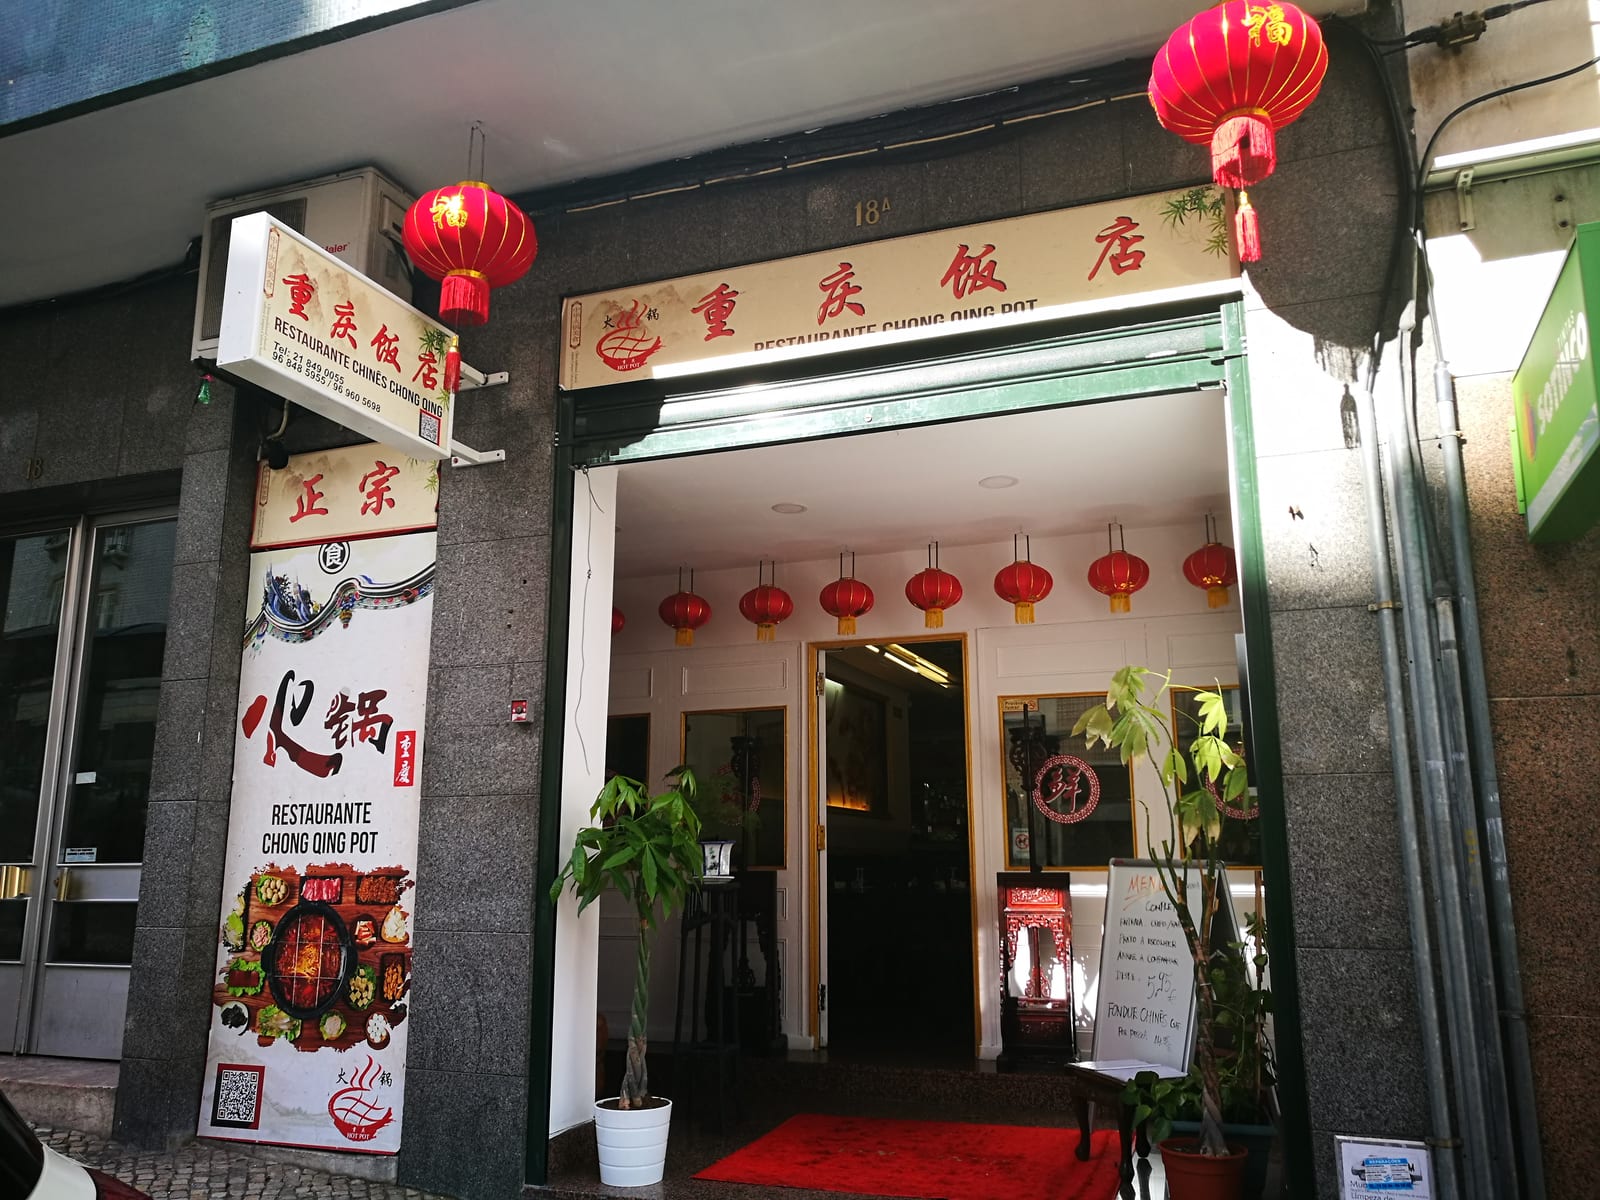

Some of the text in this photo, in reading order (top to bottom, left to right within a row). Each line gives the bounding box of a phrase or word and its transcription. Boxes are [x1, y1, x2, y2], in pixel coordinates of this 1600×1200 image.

[322, 243, 348, 254] aier
[690, 216, 1146, 342] 重庆饭店
[282, 274, 438, 391] 重庆饭店
[272, 352, 284, 364] 96
[286, 359, 302, 373] 848
[305, 367, 326, 385] 5955
[333, 382, 343, 394] 96
[345, 388, 360, 402] 960
[362, 397, 381, 413] 5698
[273, 341, 345, 385] Tel: 21 849 0055
[274, 316, 350, 370] RESTAURANTE
[352, 360, 387, 389] CHINÊS
[390, 380, 420, 407] CHONG
[422, 398, 443, 418] QING
[617, 361, 641, 371] HOT POT
[289, 460, 400, 523] 正宗
[325, 545, 343, 568] 食
[272, 802, 372, 826] RESTAURANTE
[262, 831, 379, 855] CHONG QING POT
